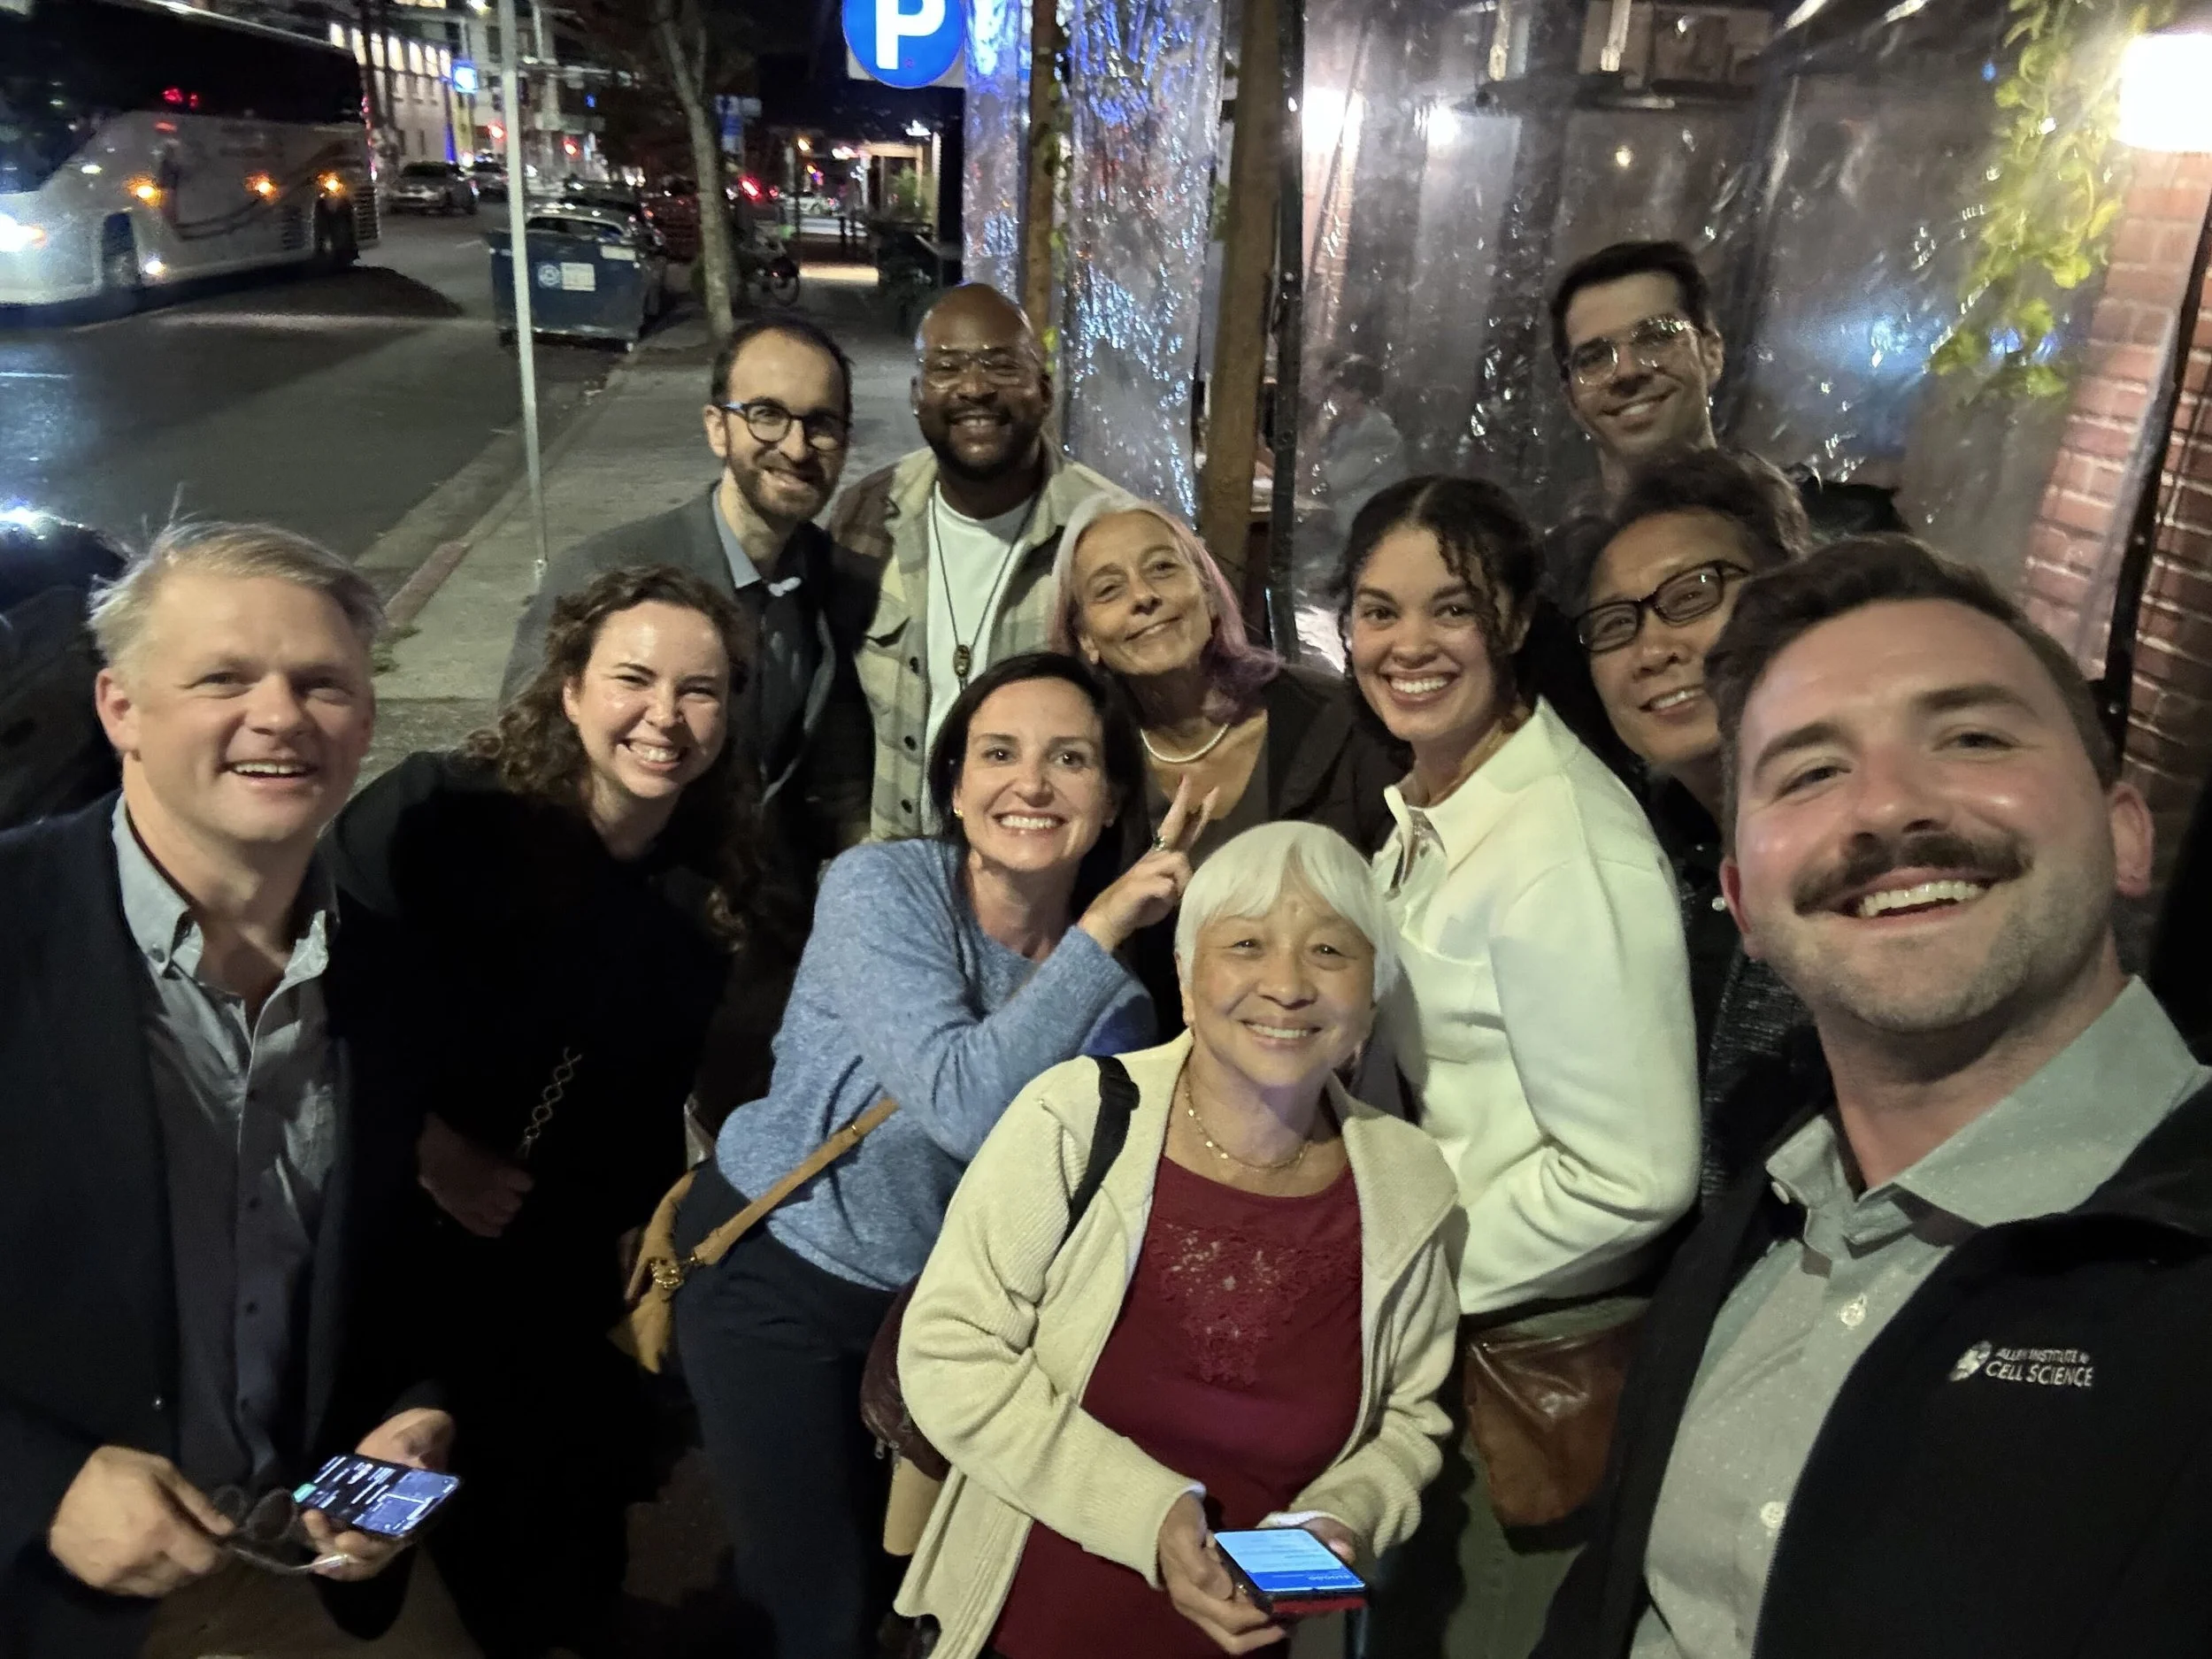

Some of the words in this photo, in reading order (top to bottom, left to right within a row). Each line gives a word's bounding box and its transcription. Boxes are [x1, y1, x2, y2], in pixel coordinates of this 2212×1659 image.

[875, 0, 946, 70] P
[1985, 1361, 2024, 1381] CELL
[2026, 1363, 2093, 1386] SCIENCE
